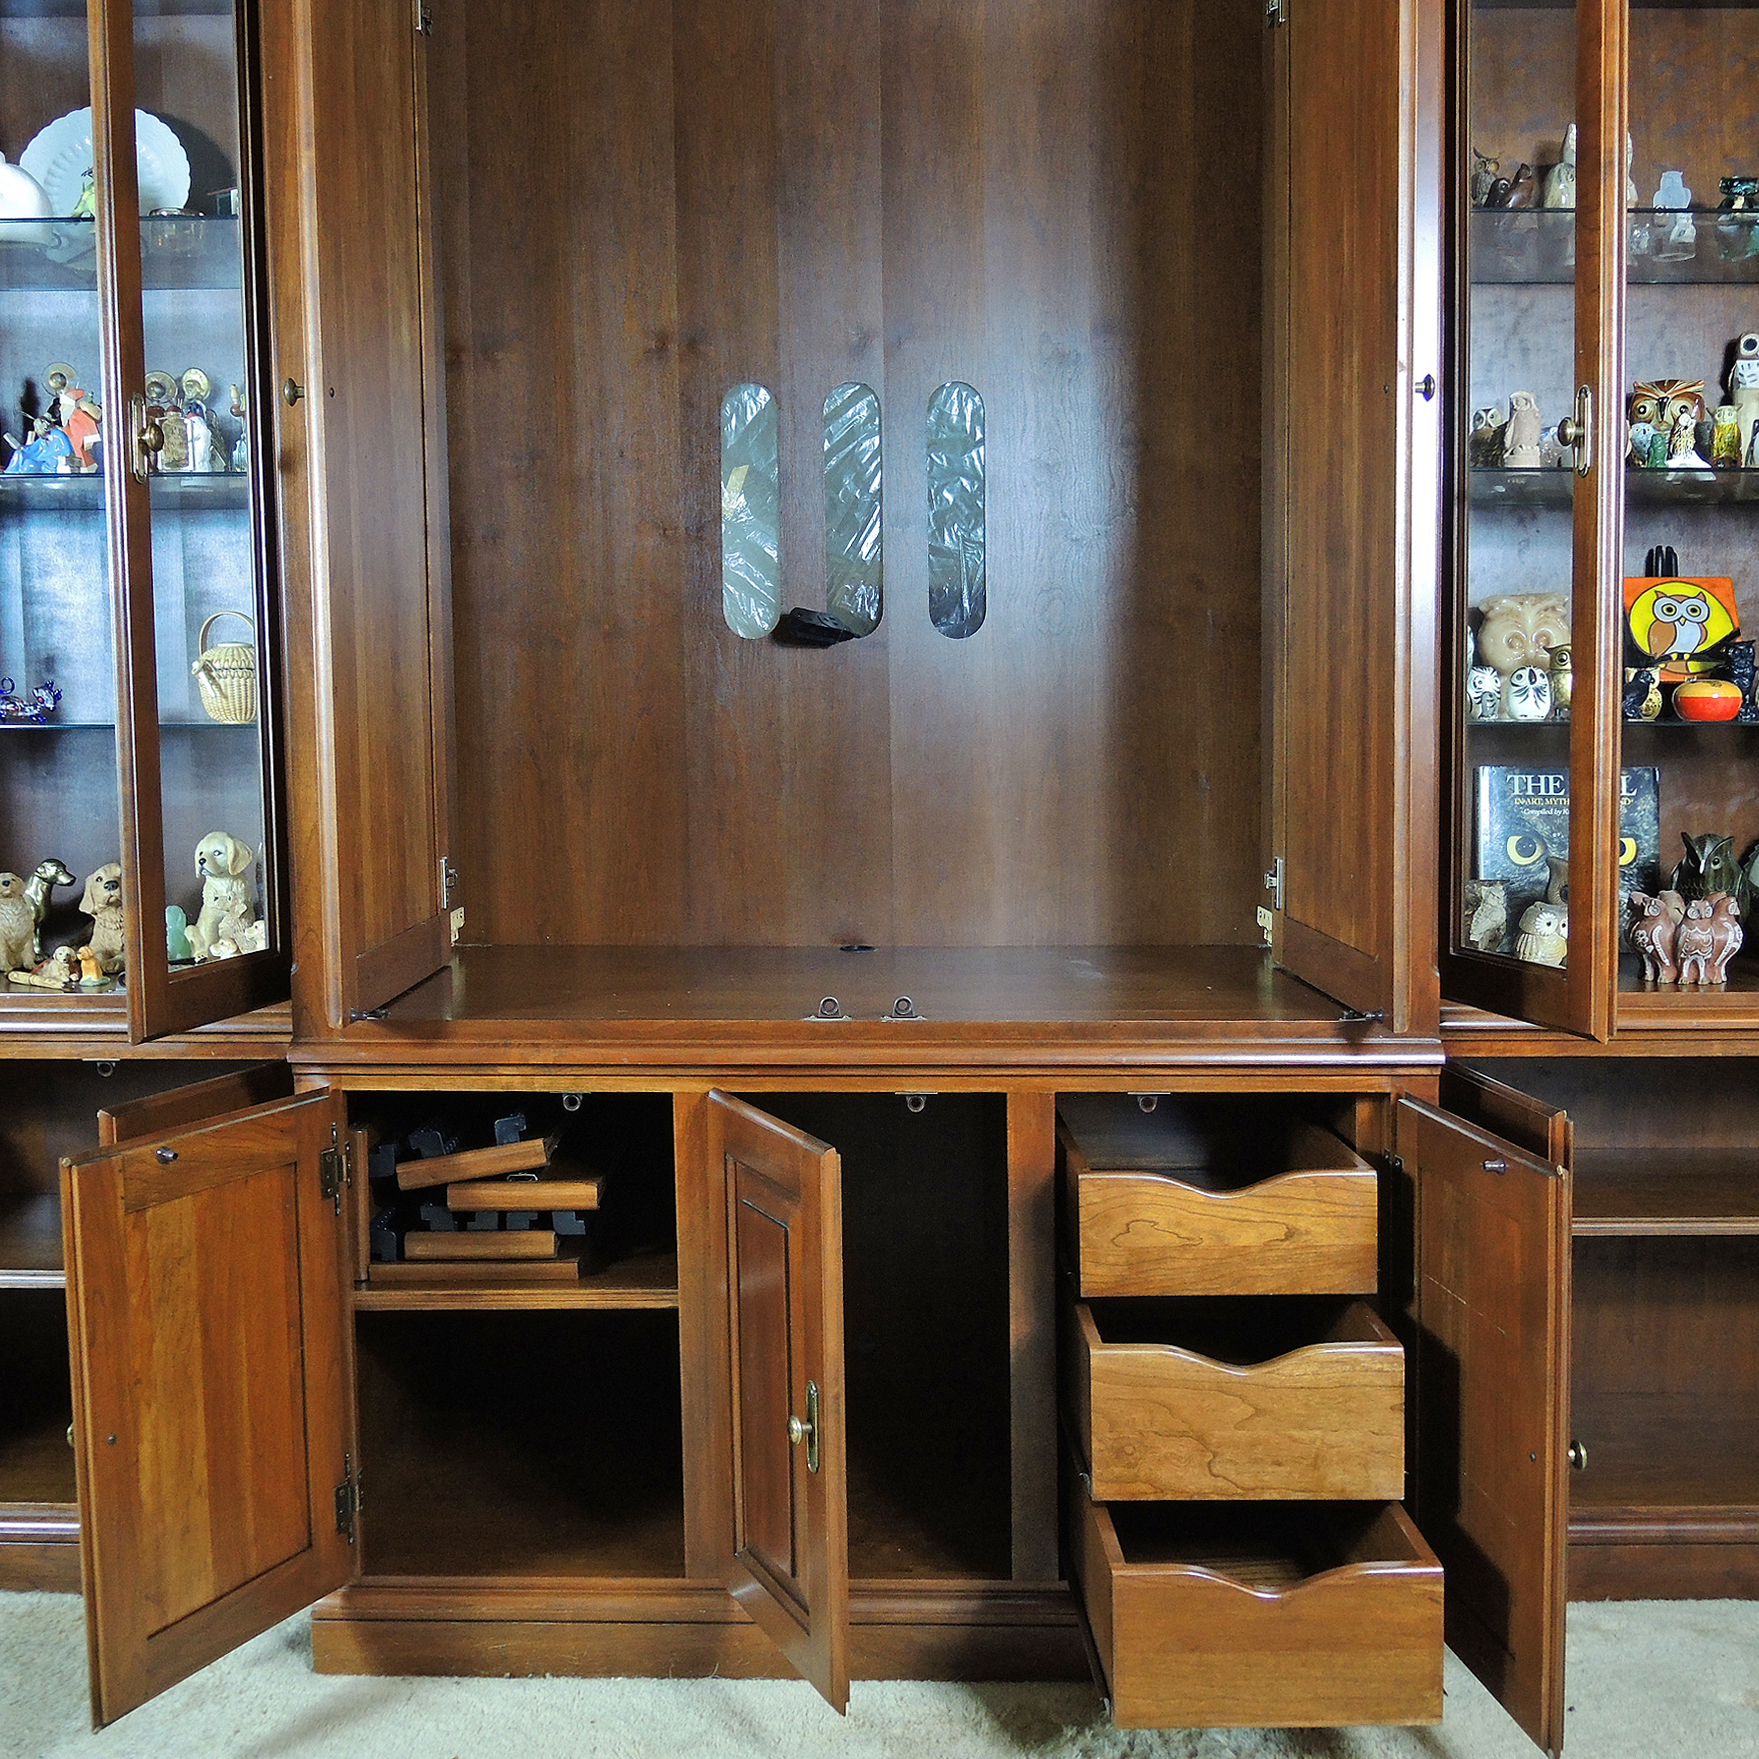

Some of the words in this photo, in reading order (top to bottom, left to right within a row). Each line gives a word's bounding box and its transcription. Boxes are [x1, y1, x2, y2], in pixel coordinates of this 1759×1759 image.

[1506, 774, 1566, 796] THE
[1523, 808, 1553, 817] Compiled
[1554, 808, 1563, 817] by
